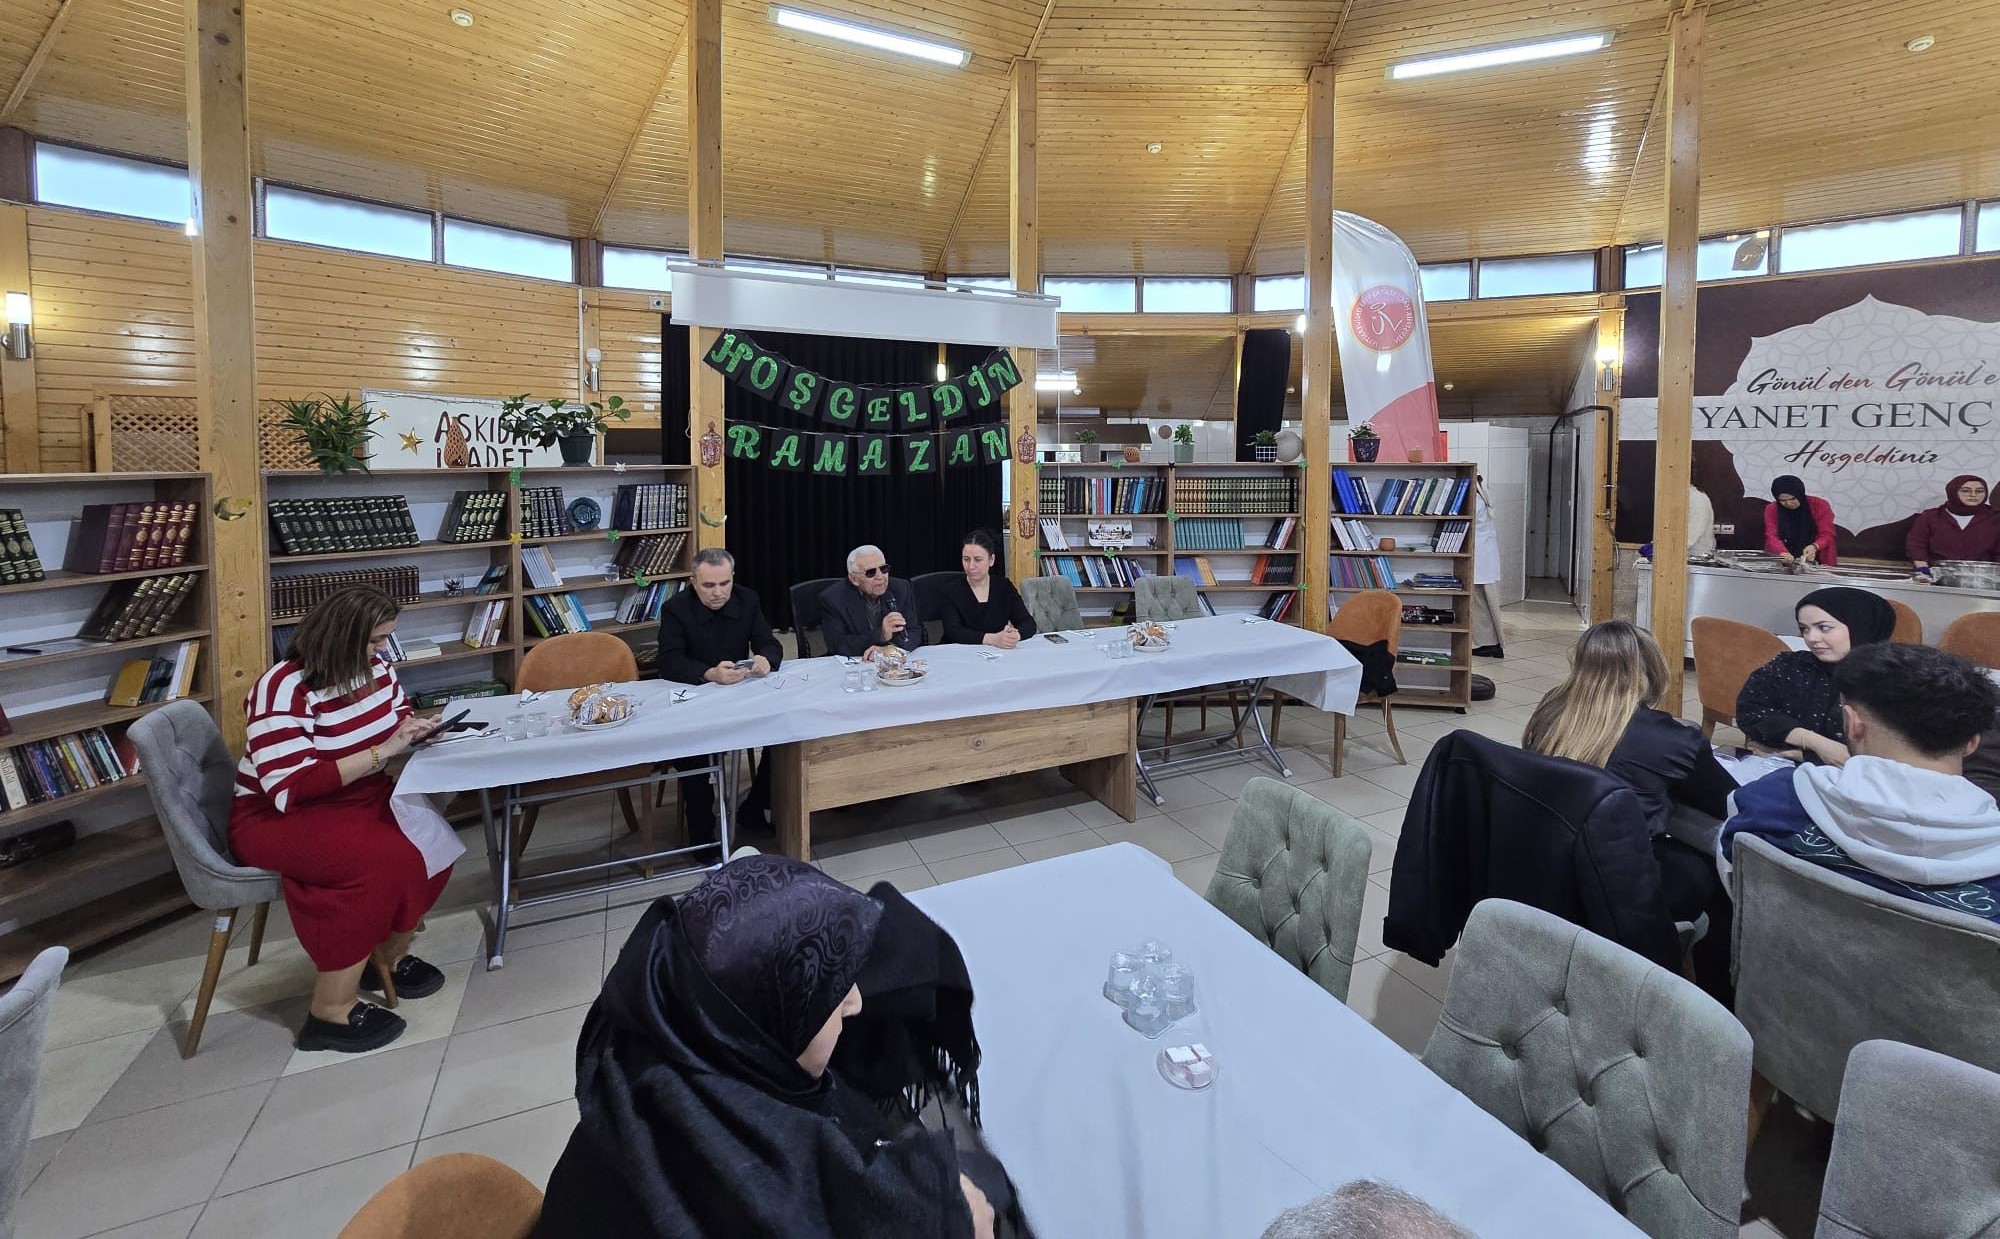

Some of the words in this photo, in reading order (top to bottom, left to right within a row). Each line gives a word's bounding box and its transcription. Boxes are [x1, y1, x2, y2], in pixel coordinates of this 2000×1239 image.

[1851, 400, 1993, 434] GENÇ
[728, 424, 1008, 473] RAMAZAN
[1784, 440, 1943, 473] Hoşgeldiniz
